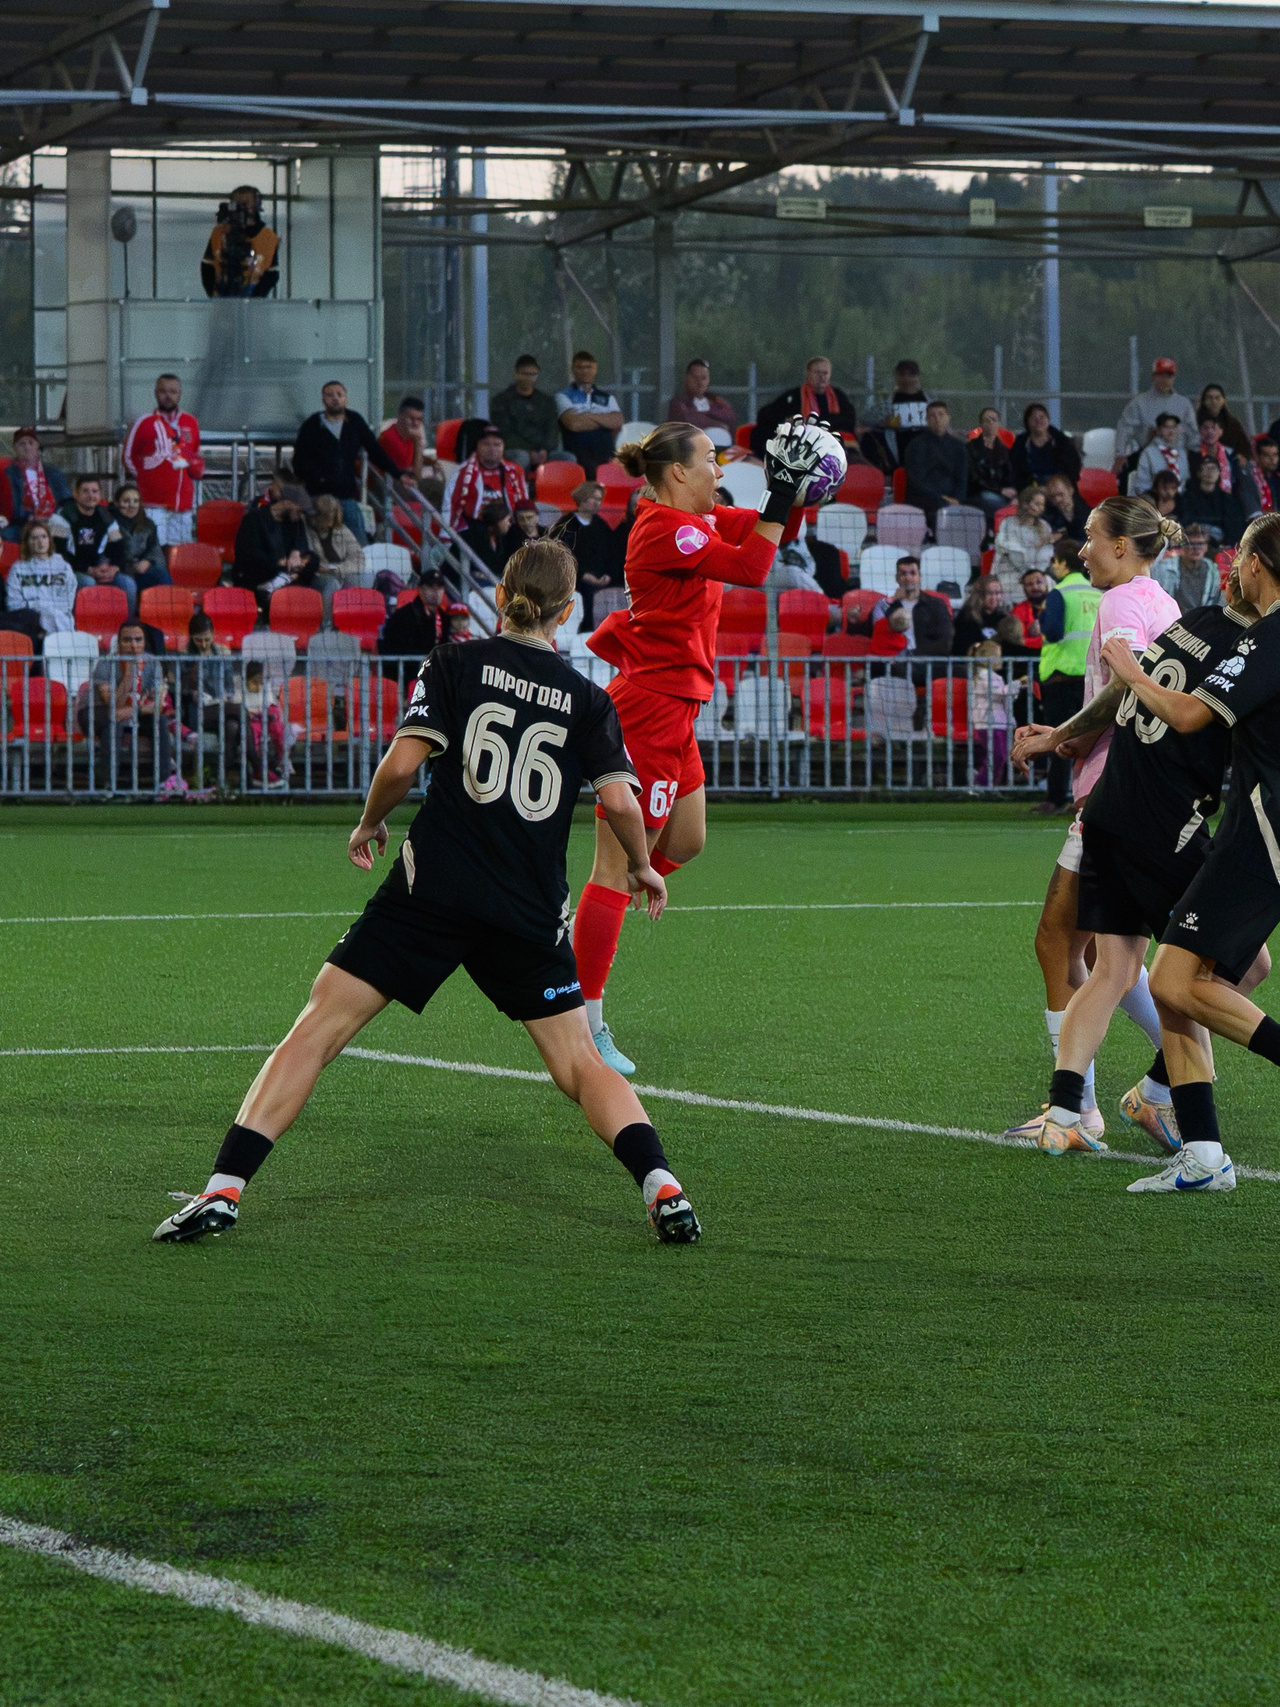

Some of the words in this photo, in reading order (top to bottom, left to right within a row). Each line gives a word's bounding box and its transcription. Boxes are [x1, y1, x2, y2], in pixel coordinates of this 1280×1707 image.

[481, 665, 572, 715] ПИРОГОВА
[462, 702, 568, 822] 66
[649, 780, 678, 818] 63
